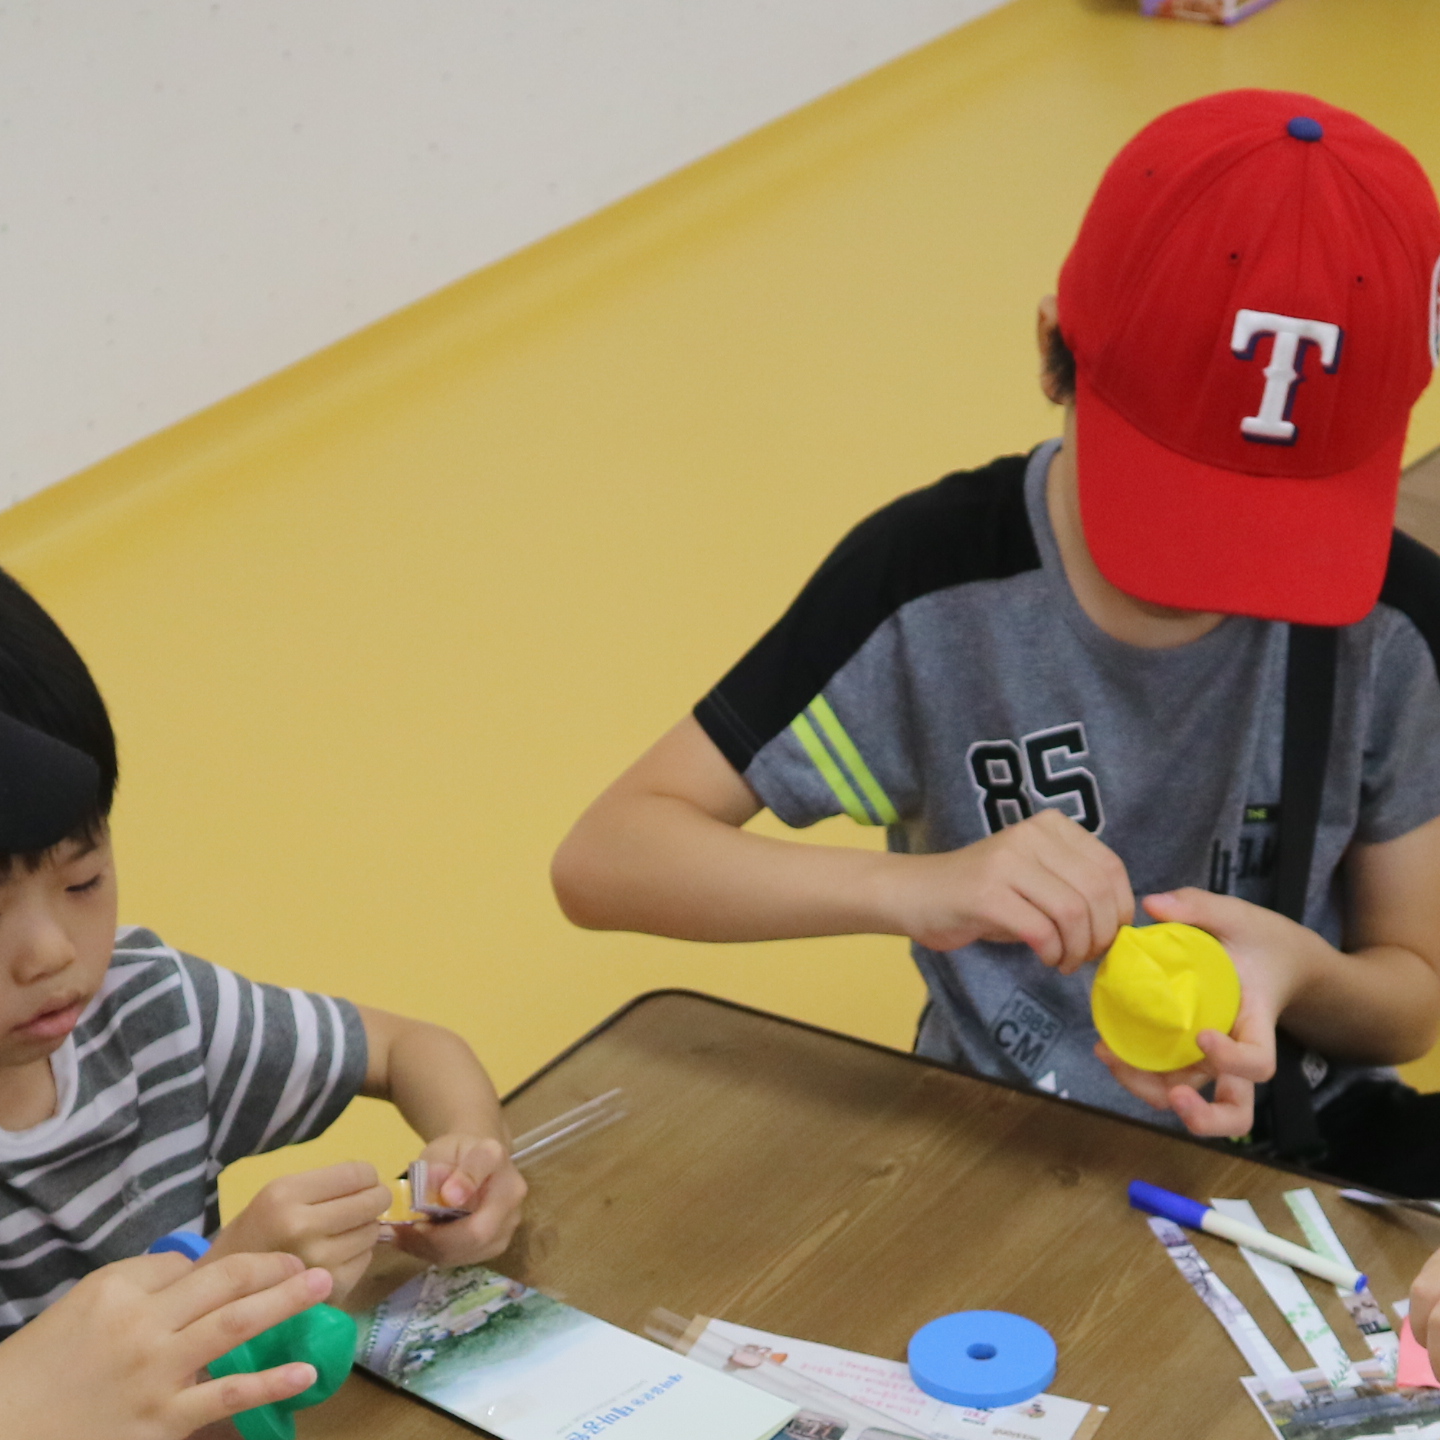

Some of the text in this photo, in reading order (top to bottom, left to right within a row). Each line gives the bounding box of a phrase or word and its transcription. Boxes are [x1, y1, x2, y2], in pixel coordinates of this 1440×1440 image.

[1230, 308, 1344, 446] T
[966, 720, 1105, 836] 85
[995, 1019, 1046, 1068] CM
